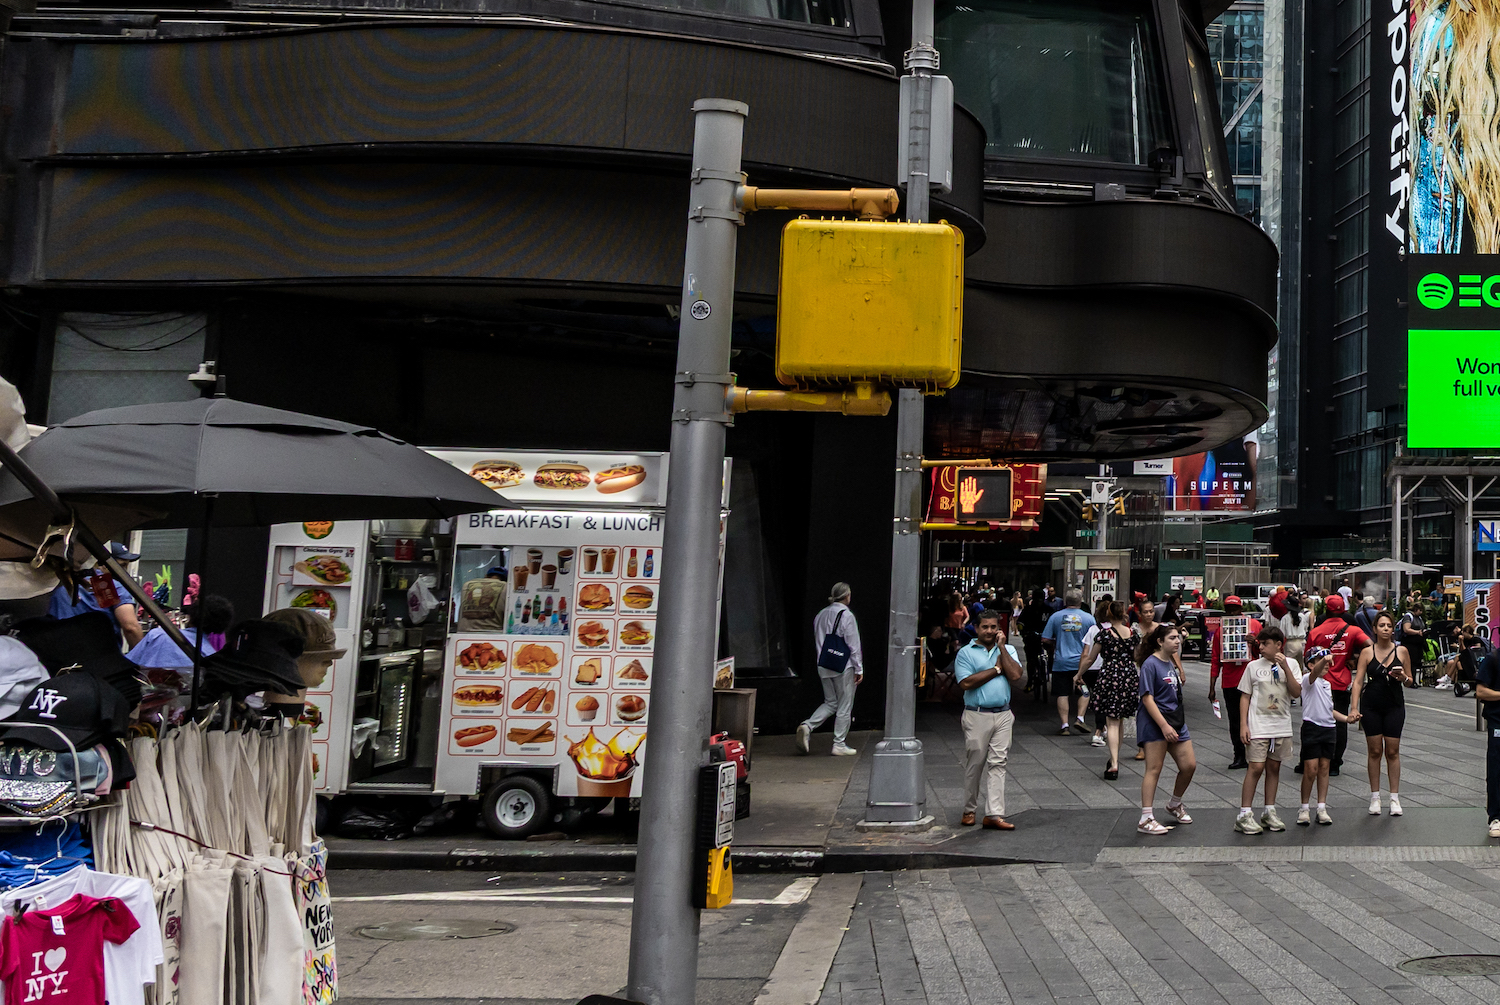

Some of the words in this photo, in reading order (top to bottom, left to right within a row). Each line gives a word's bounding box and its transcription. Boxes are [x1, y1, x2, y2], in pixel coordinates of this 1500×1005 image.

[1453, 379, 1483, 398] full
[469, 514, 573, 529] BREAKFAST
[582, 516, 597, 530] &
[602, 517, 661, 532] LUNCH
[1092, 570, 1116, 579] ATM
[1092, 583, 1115, 592] Drink
[28, 688, 67, 719] NY
[32, 951, 43, 975] I
